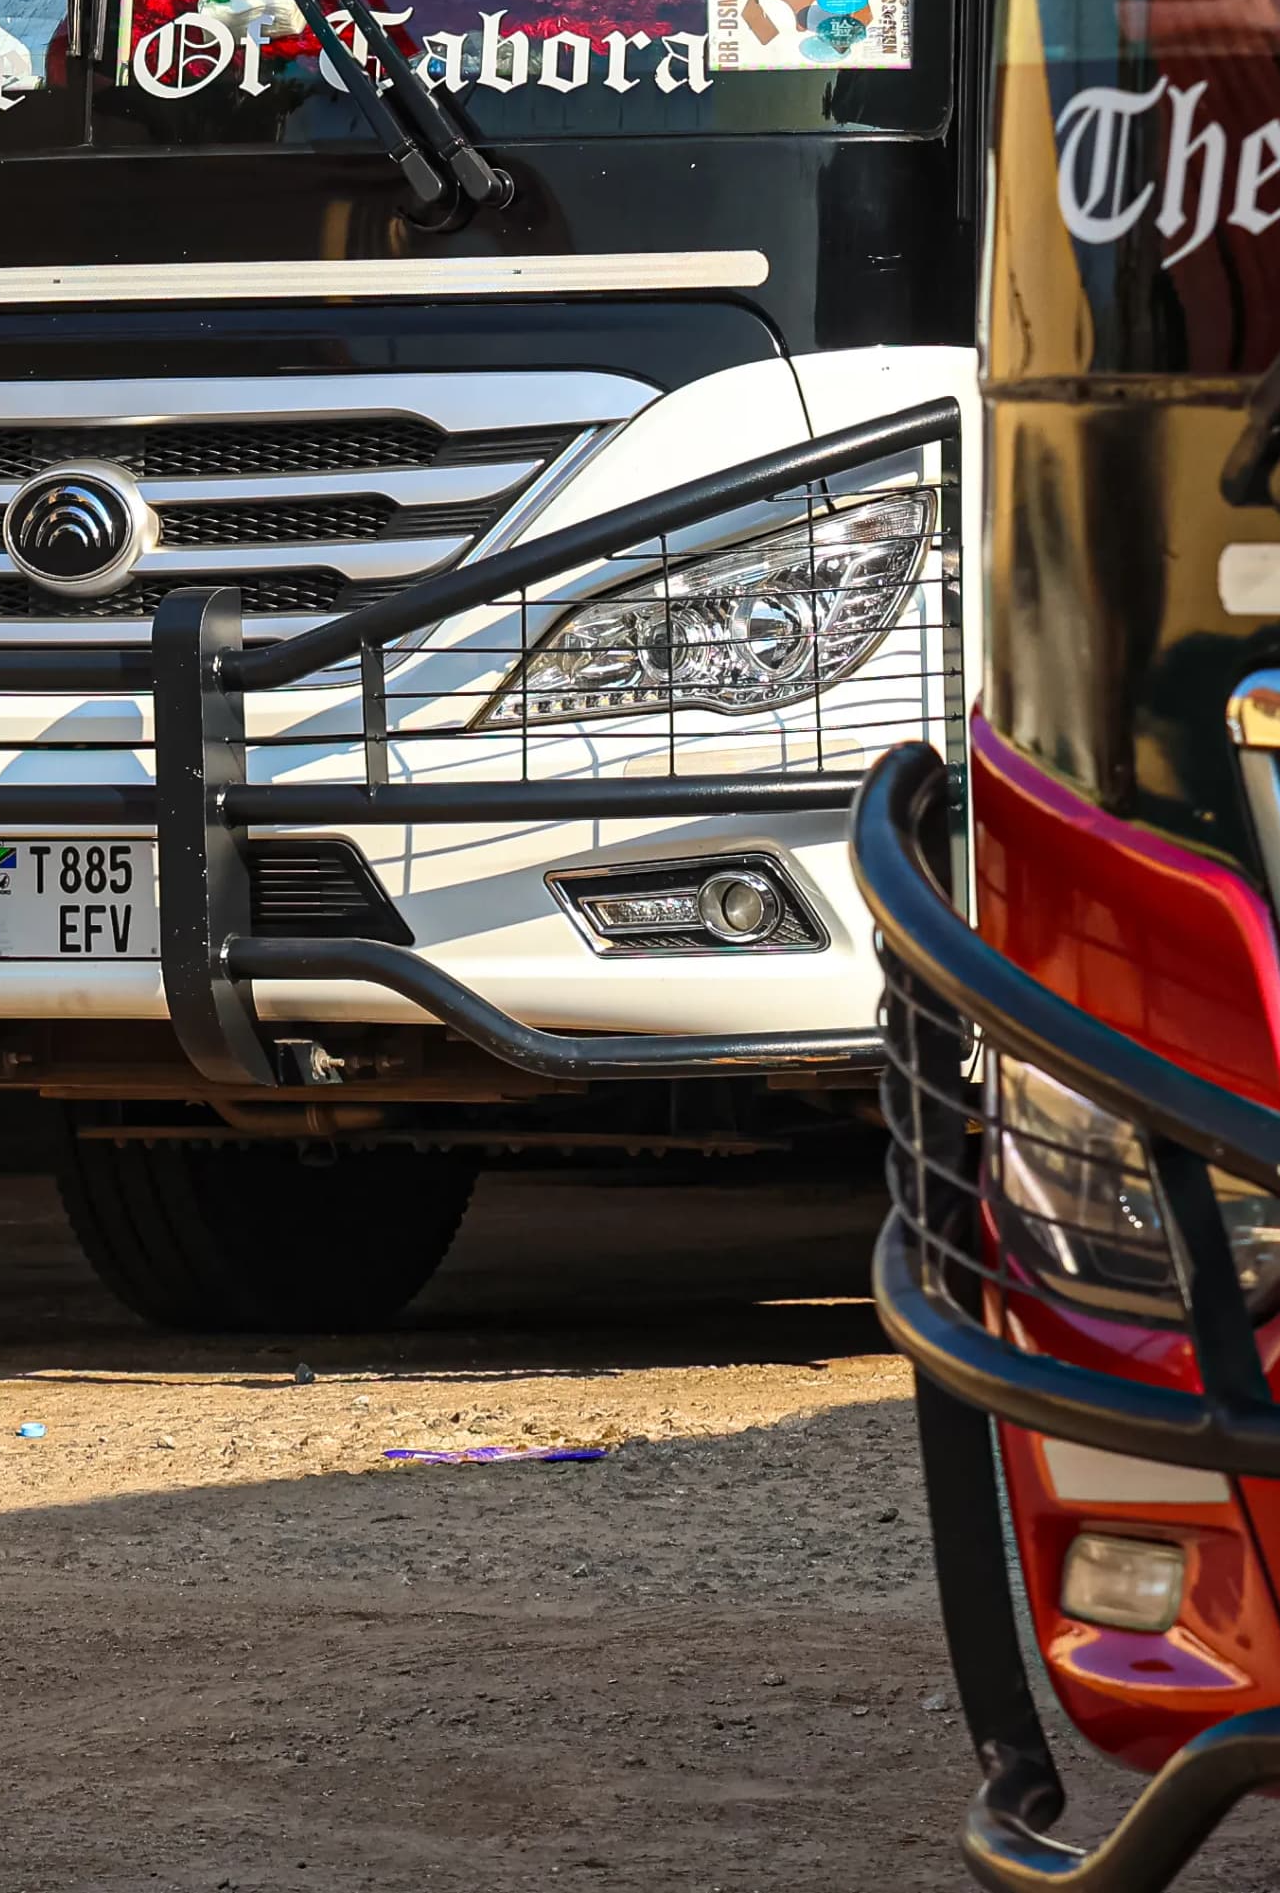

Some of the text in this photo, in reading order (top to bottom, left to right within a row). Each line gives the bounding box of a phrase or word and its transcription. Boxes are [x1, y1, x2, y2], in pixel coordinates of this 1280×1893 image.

[133, 12, 275, 99] Of
[717, 41, 739, 70] TBR
[29, 845, 133, 894] T 885
[59, 905, 132, 953] EFV
